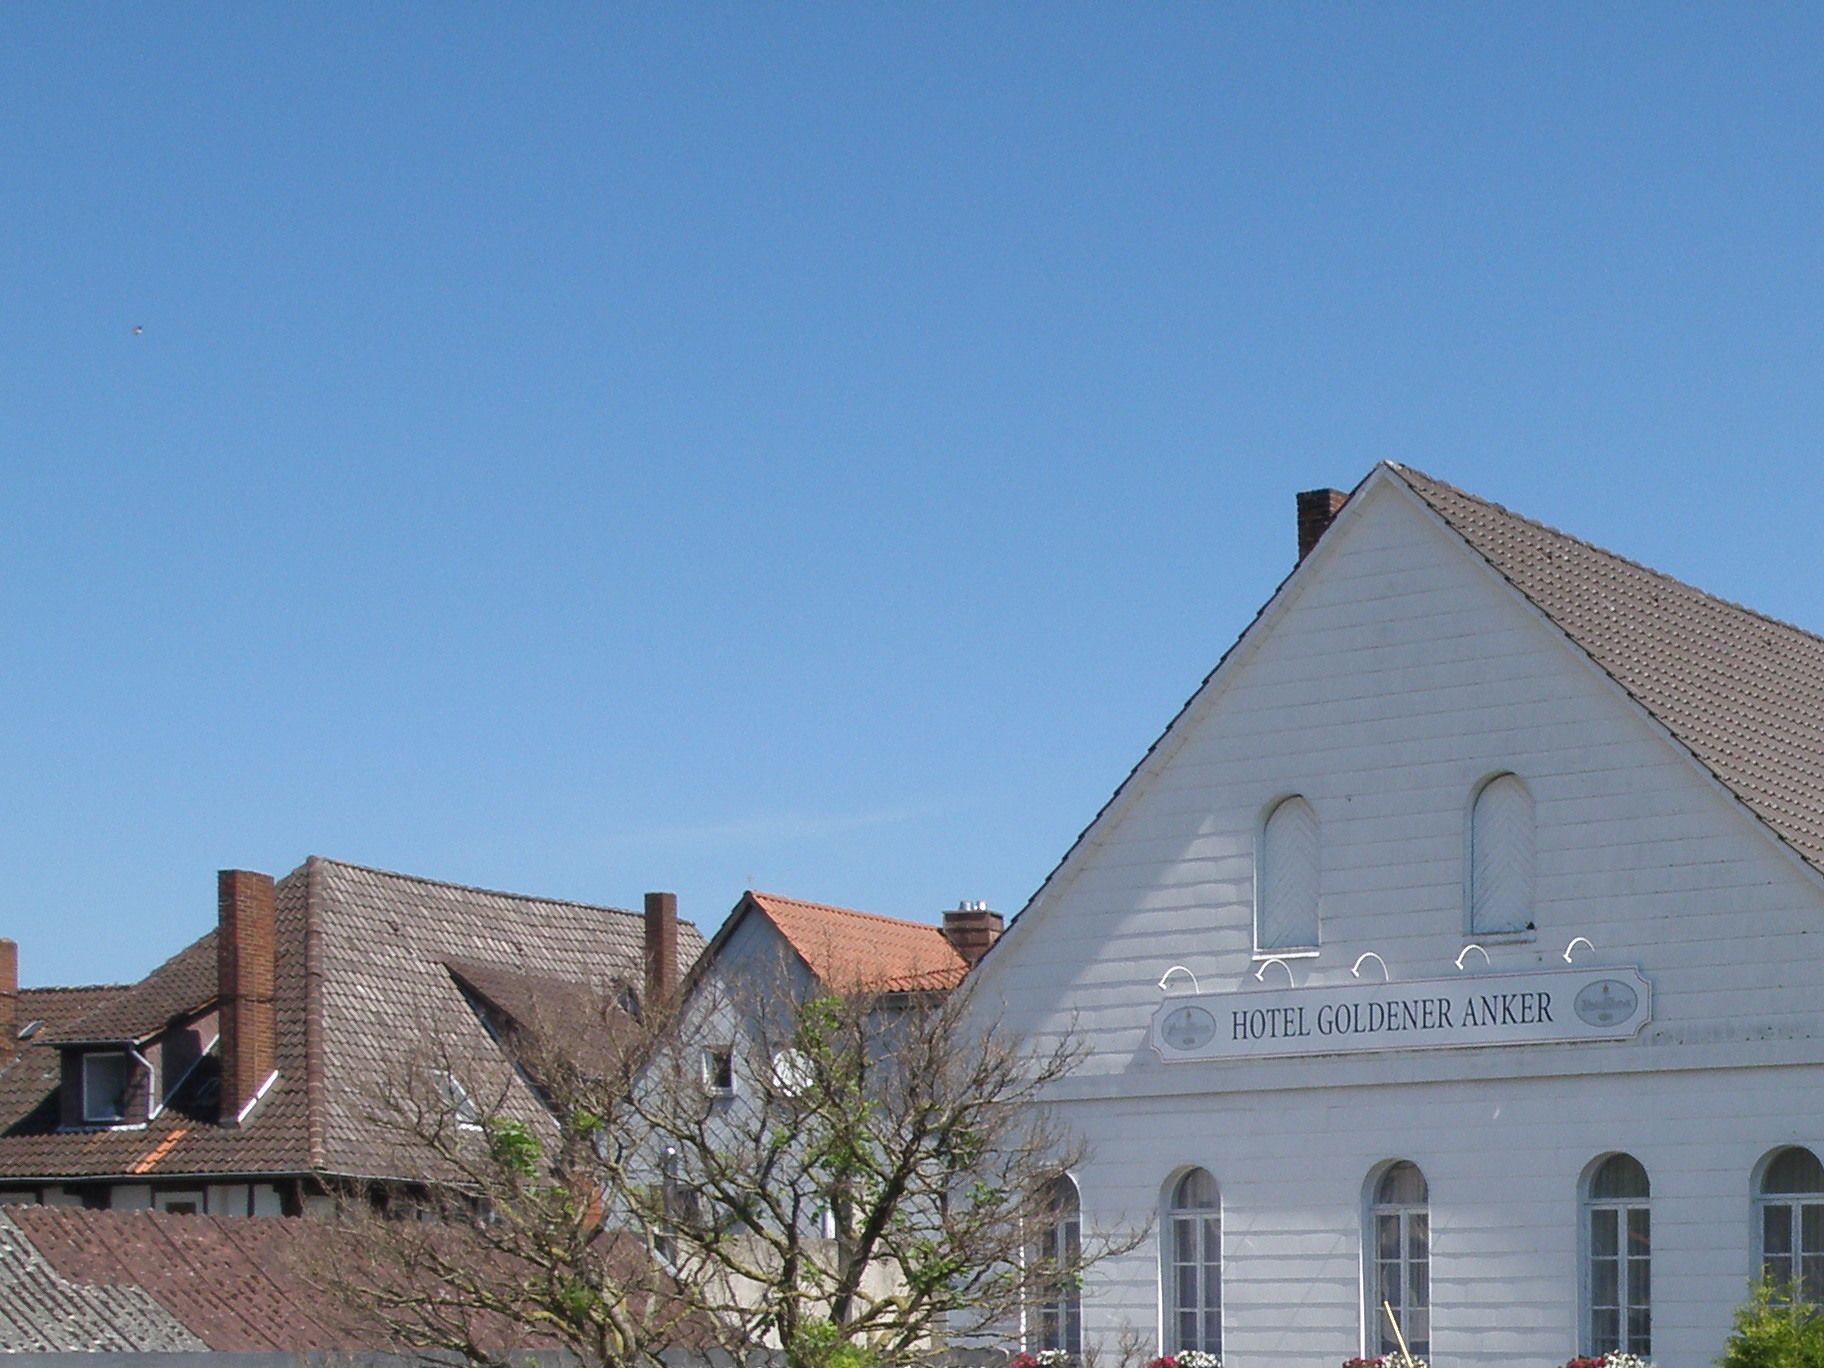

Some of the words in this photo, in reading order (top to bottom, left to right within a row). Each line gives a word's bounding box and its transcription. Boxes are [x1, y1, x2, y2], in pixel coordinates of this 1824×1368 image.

[1232, 1007, 1311, 1040] HOTEL
[1318, 998, 1453, 1035] GOLDENER
[1461, 992, 1554, 1027] ANKER
